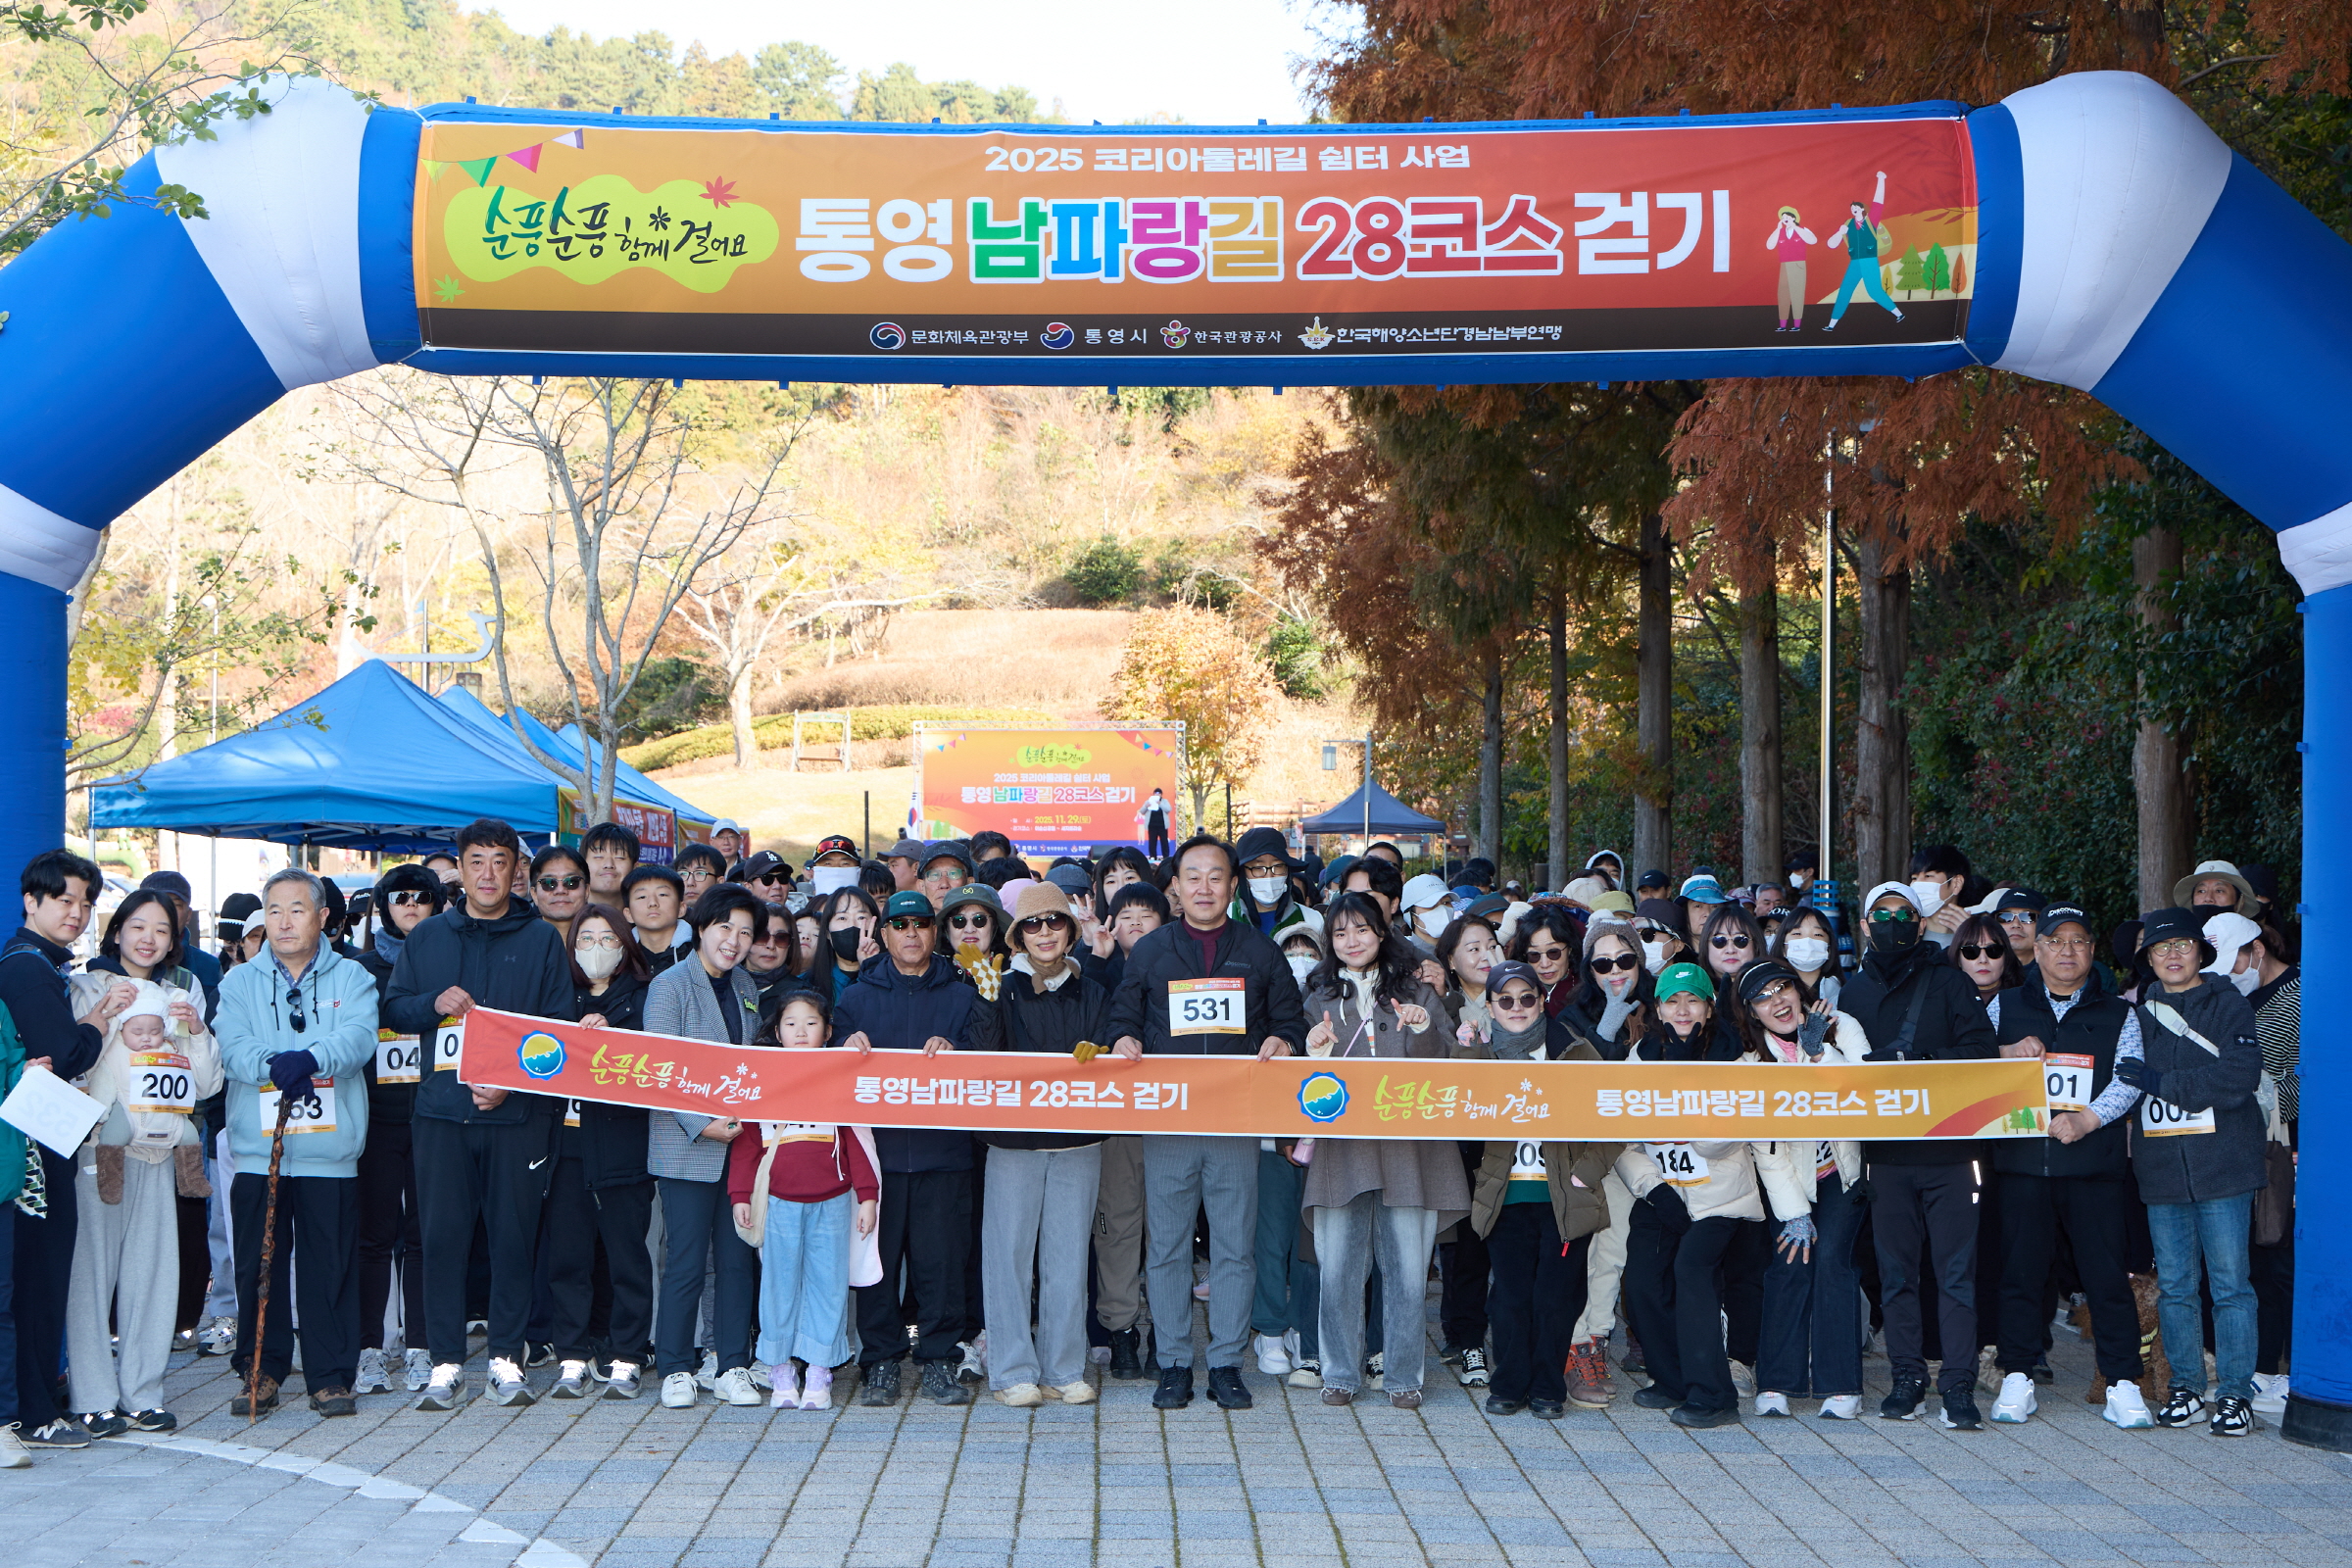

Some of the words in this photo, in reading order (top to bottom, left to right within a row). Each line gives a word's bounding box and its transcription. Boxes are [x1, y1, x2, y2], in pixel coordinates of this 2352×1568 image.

[984, 145, 1084, 173] 2025
[1093, 146, 1308, 173] 코리아둘레길
[1318, 145, 1389, 172] 쉼터
[1399, 144, 1471, 169] 사업
[481, 184, 612, 262] 순풍순풍
[613, 216, 670, 263] 함께
[672, 219, 750, 265] 걸어요
[794, 197, 955, 284] 통영
[966, 195, 1286, 285] 남파랑길
[1295, 193, 1565, 282] 28코스
[1573, 189, 1731, 275] 걷기
[909, 328, 1030, 346] 문화체육관광부
[1194, 329, 1283, 344] 한국관광공사
[994, 773, 1018, 783] 2025
[960, 786, 992, 804] 통영
[993, 785, 1054, 804] 남파랑길
[1054, 785, 1104, 804] 28코스
[1104, 786, 1136, 804] 걷기
[1183, 997, 1230, 1021] 531
[141, 1072, 189, 1100] 200
[589, 1043, 676, 1089] 순풍순풍
[675, 1066, 711, 1099] 함께
[713, 1074, 762, 1104] 걸어요
[853, 1075, 1022, 1107] 통영남파랑길
[1029, 1080, 1125, 1109] 28코스
[1132, 1081, 1189, 1111] 걷기
[1372, 1074, 1460, 1122] 순풍순풍
[1459, 1089, 1497, 1120] 함께
[1500, 1093, 1551, 1123] 걸어요
[1594, 1088, 1765, 1118] 통영남파랑길
[1772, 1090, 1868, 1117] 28코스
[1874, 1088, 1931, 1116] 걷기
[2148, 1098, 2203, 1124] 00
[1655, 1150, 1695, 1174] 184
